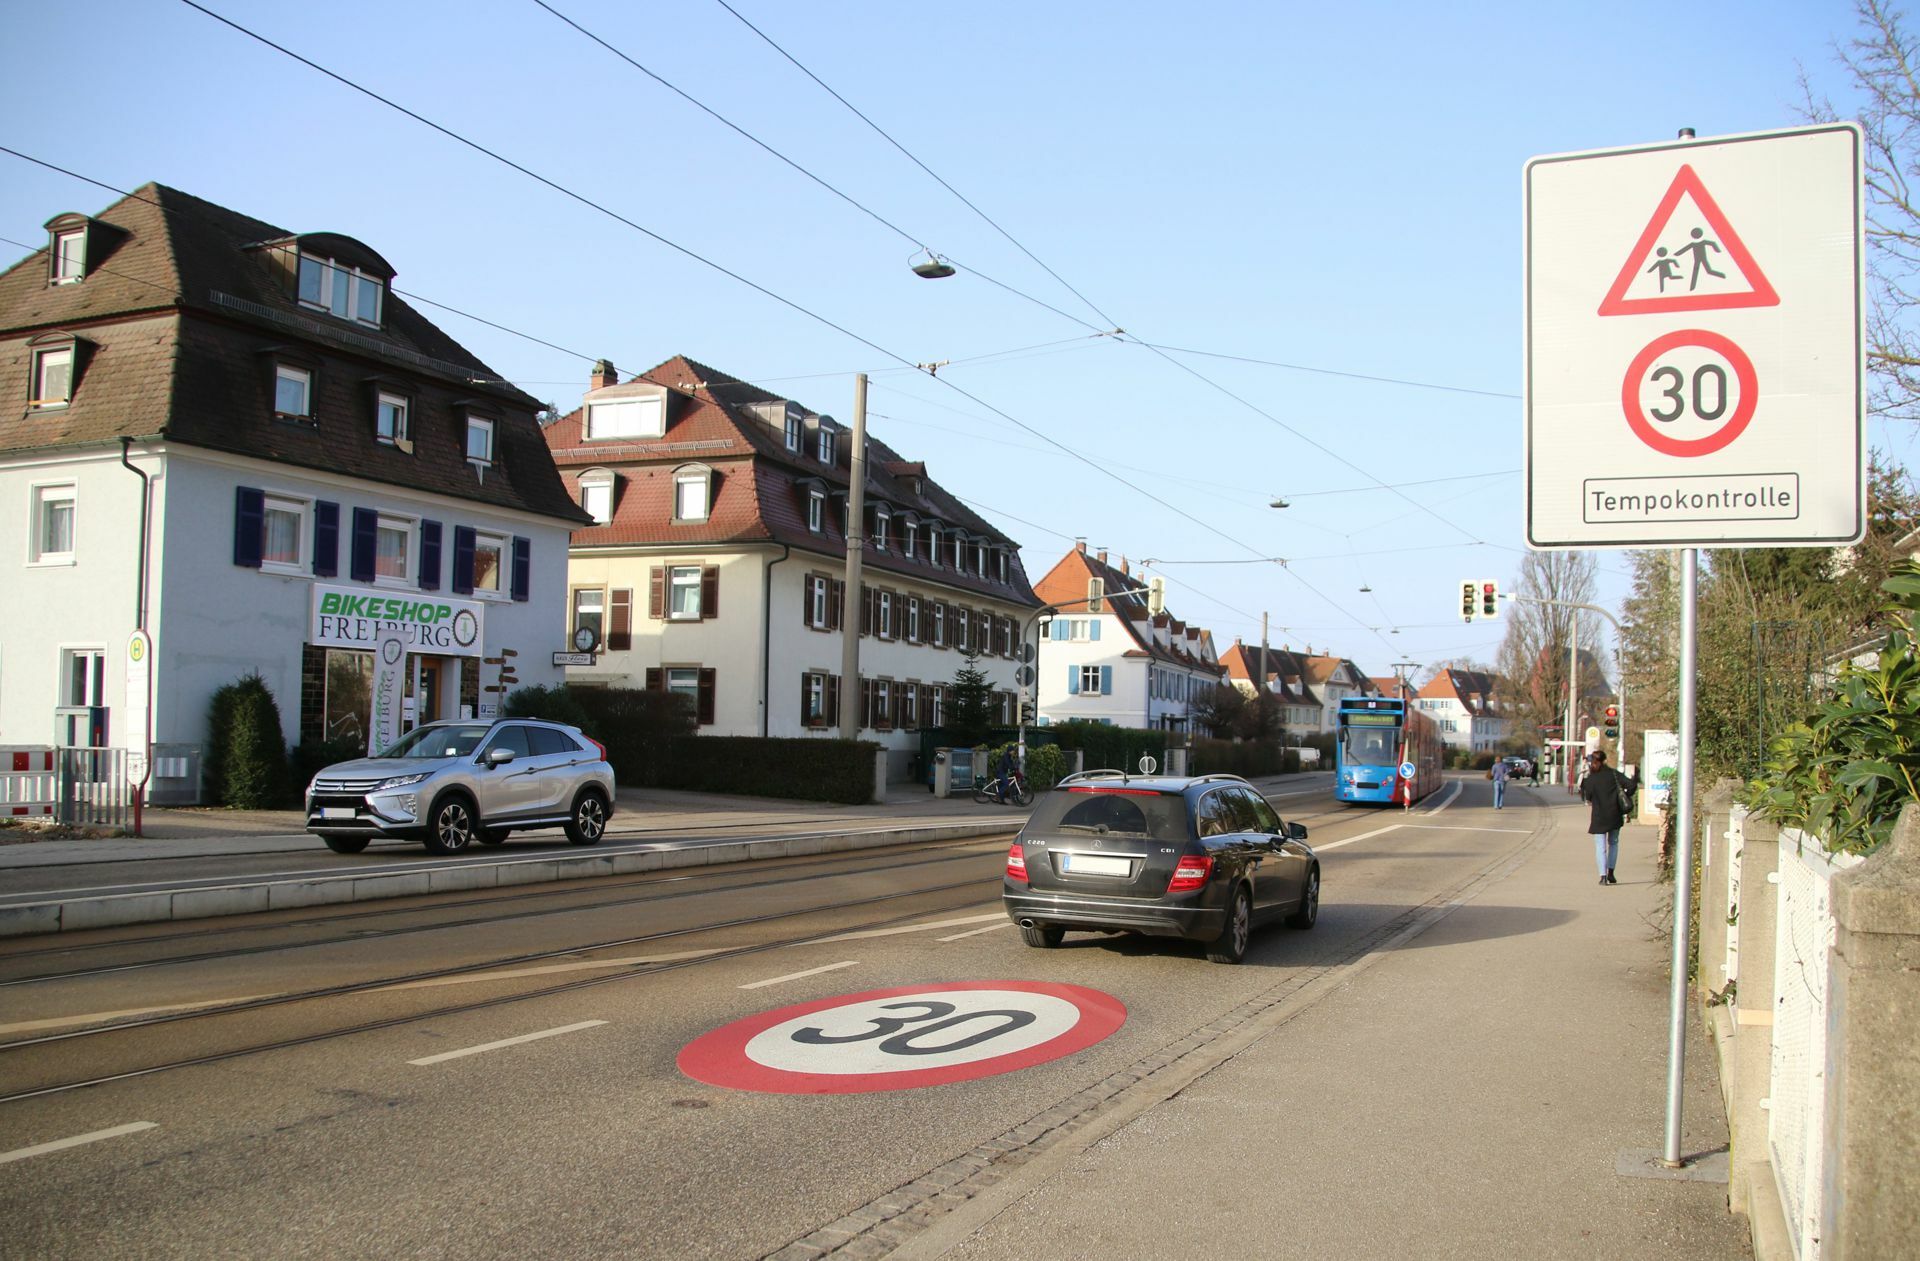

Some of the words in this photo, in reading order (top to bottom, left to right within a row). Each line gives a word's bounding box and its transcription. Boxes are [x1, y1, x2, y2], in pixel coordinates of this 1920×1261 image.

[1650, 363, 1727, 423] 30
[1591, 485, 1792, 516] Tempokontrolle
[319, 592, 452, 625] BIKESHOP
[790, 1000, 1037, 1056] 30
